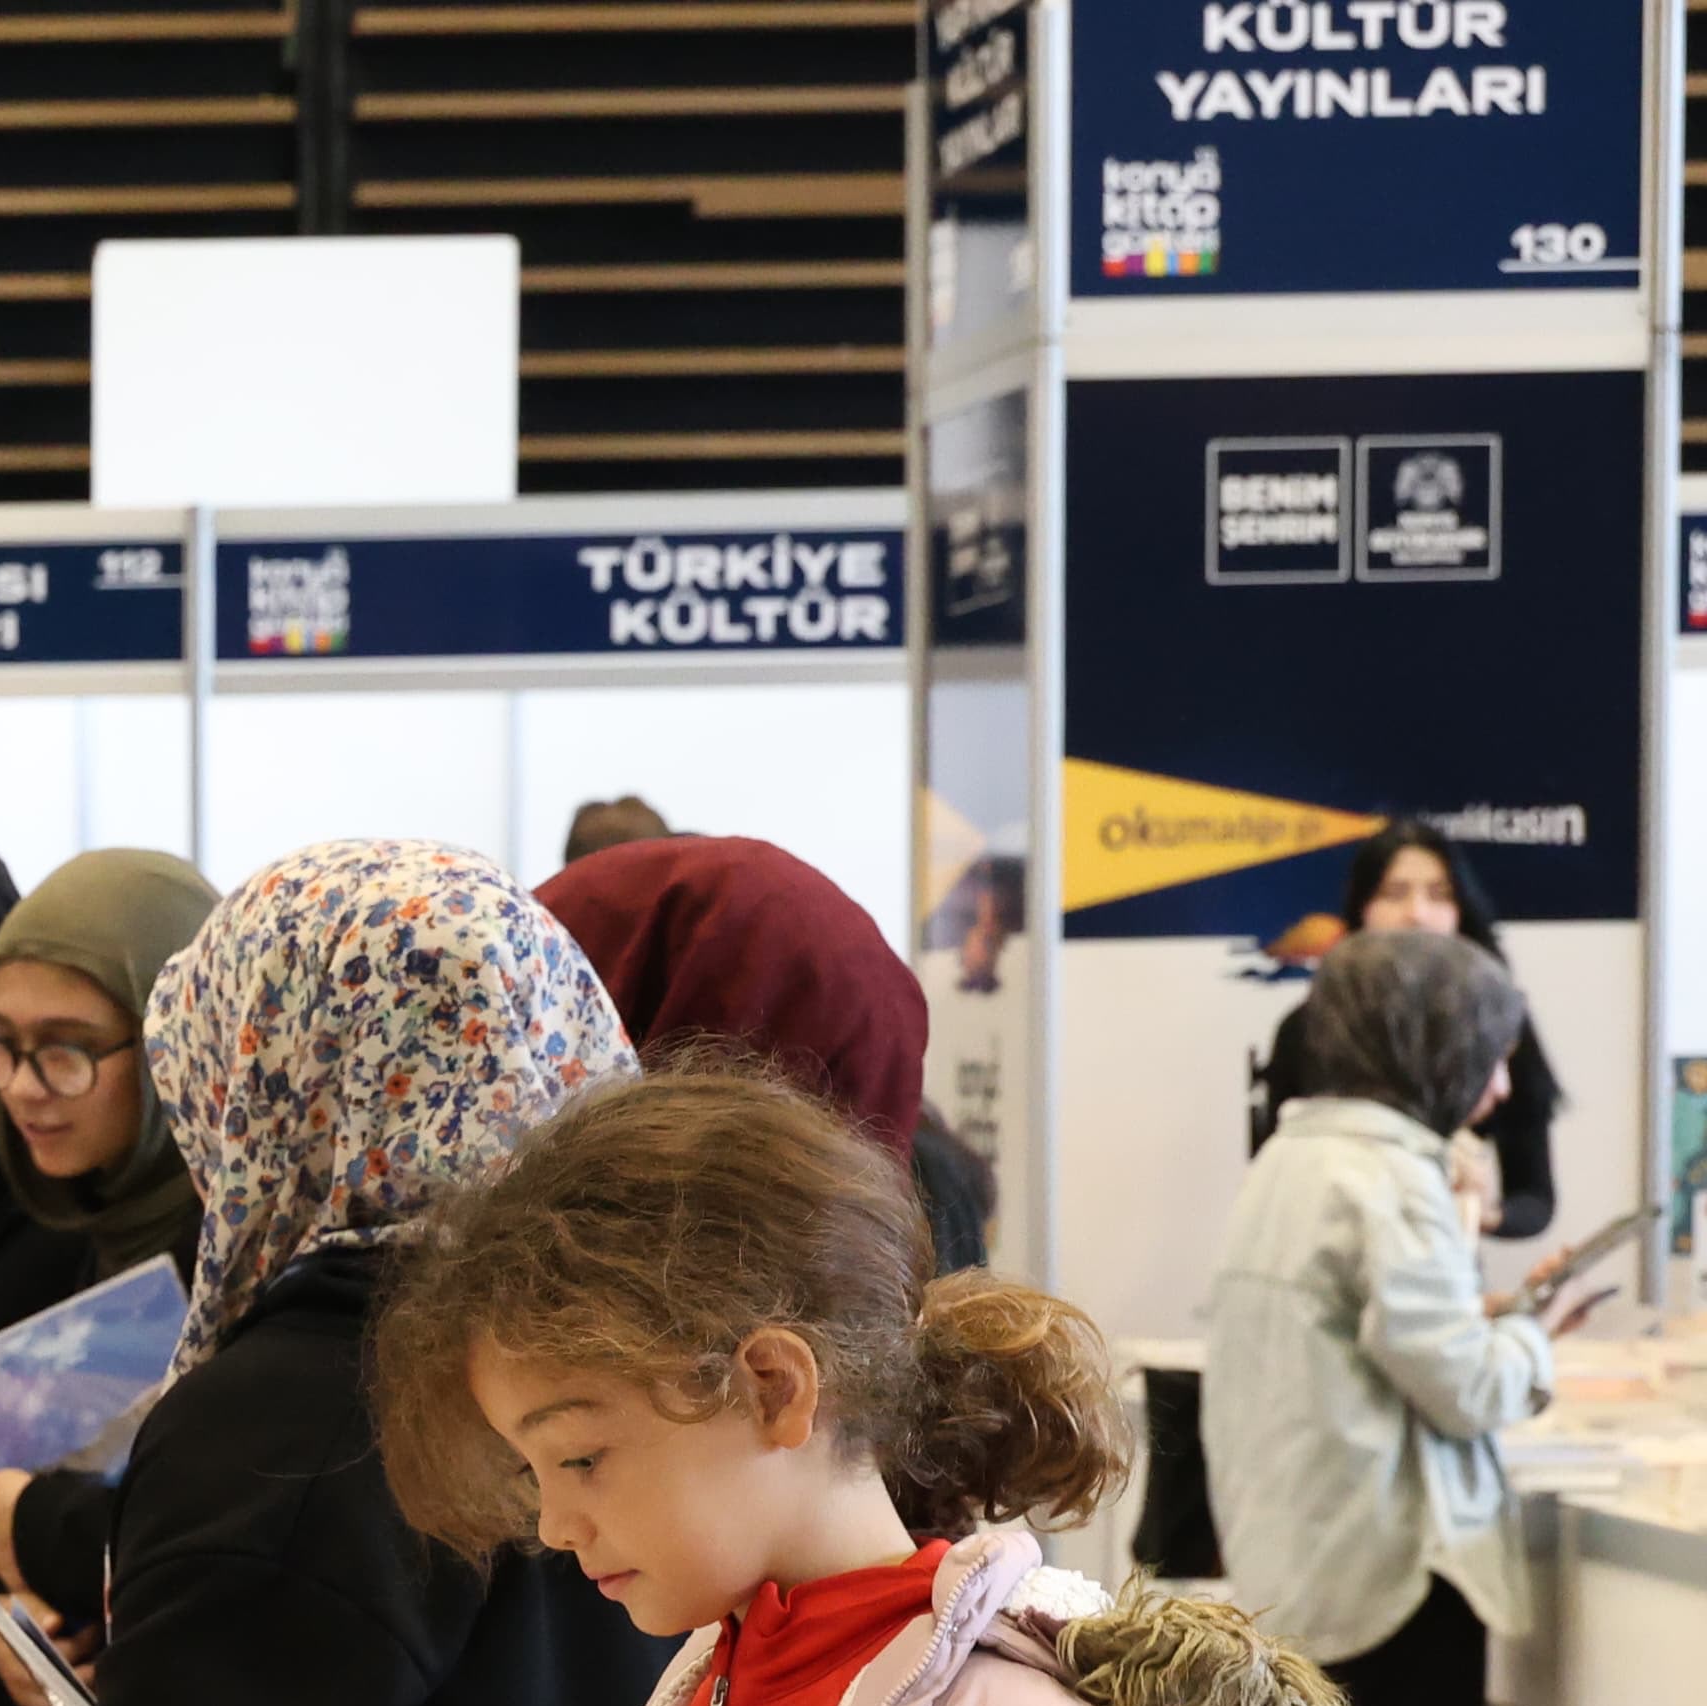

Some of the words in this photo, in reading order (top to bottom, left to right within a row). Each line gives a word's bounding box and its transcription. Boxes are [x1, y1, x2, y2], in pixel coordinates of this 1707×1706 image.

[1201, 0, 1508, 53] KÜLTÜR
[1155, 65, 1547, 121] YAYINLARI
[1509, 223, 1607, 264] 130
[99, 548, 163, 581] 112
[580, 536, 887, 590] TÜRKİYE
[609, 588, 890, 644] KÜLTÜR
